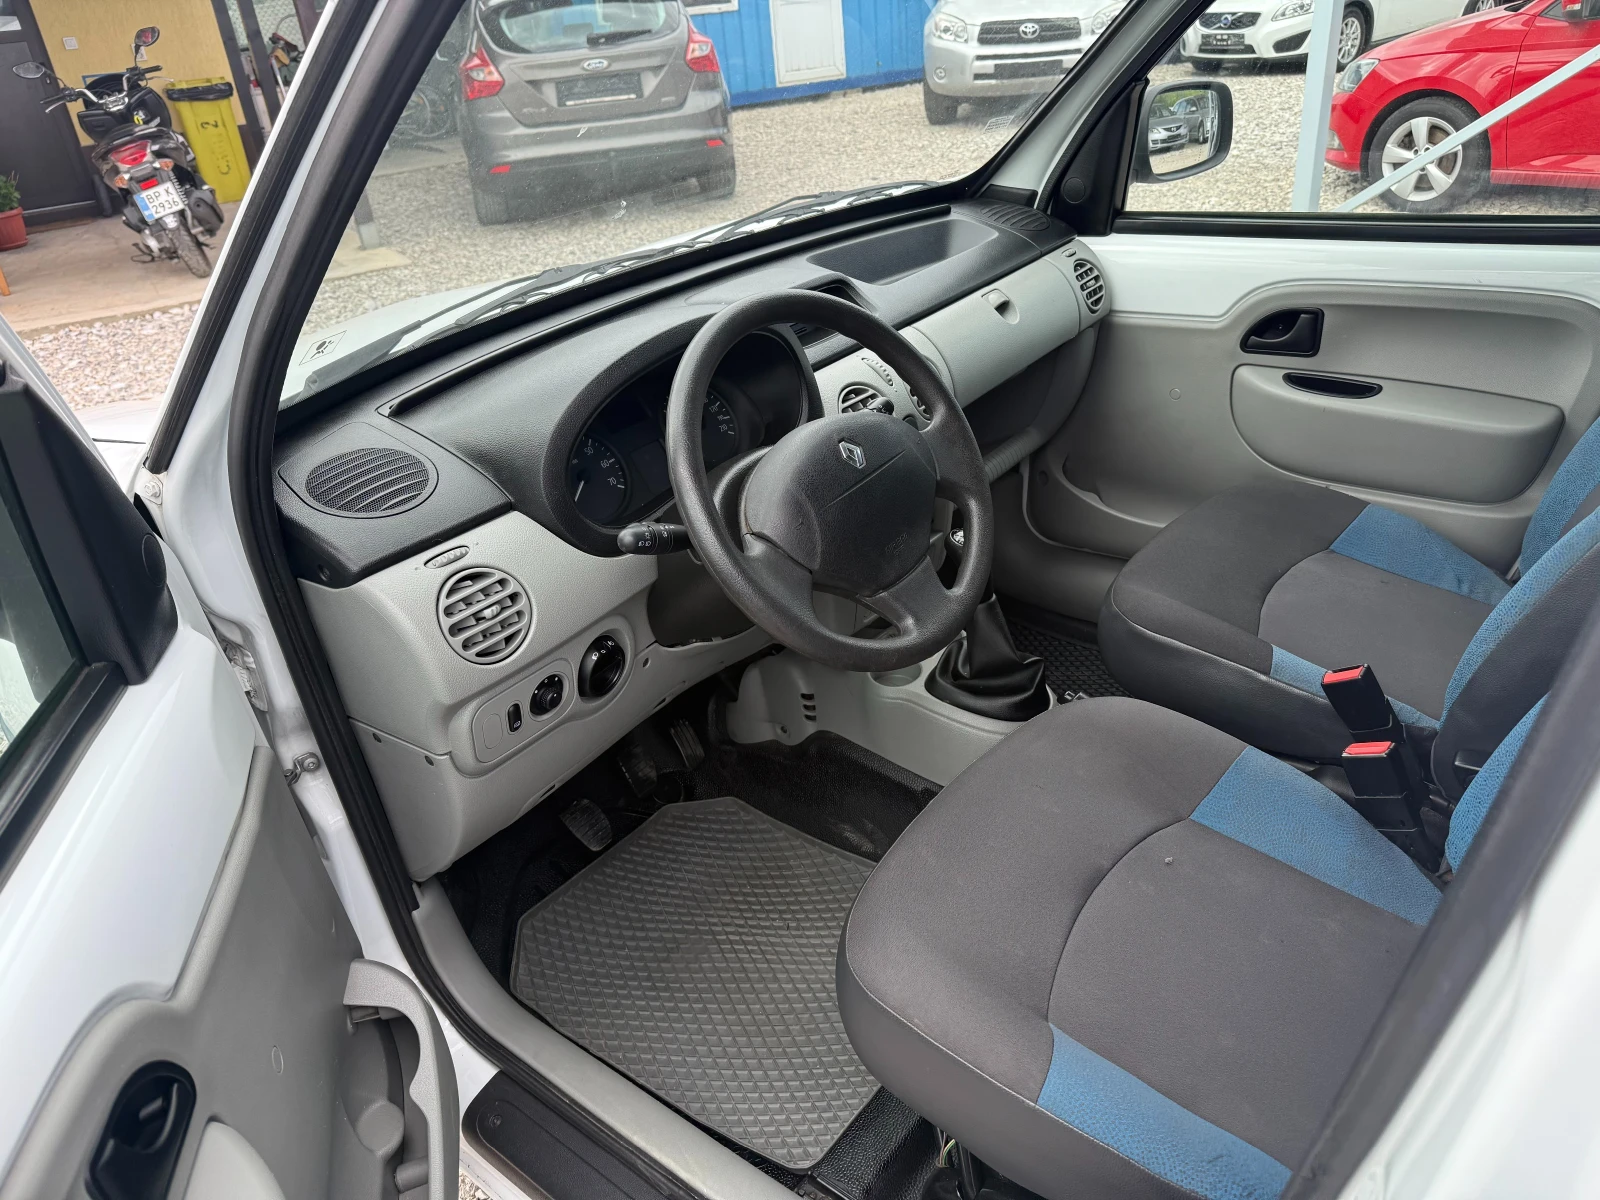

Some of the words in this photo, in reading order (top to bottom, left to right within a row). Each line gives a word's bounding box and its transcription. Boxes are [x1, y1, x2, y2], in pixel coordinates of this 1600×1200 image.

[145, 190, 161, 204] BP
[163, 186, 174, 197] K
[151, 197, 180, 215] 2936
[583, 446, 594, 456] 50
[600, 459, 610, 469] 60
[607, 476, 617, 486] 70
